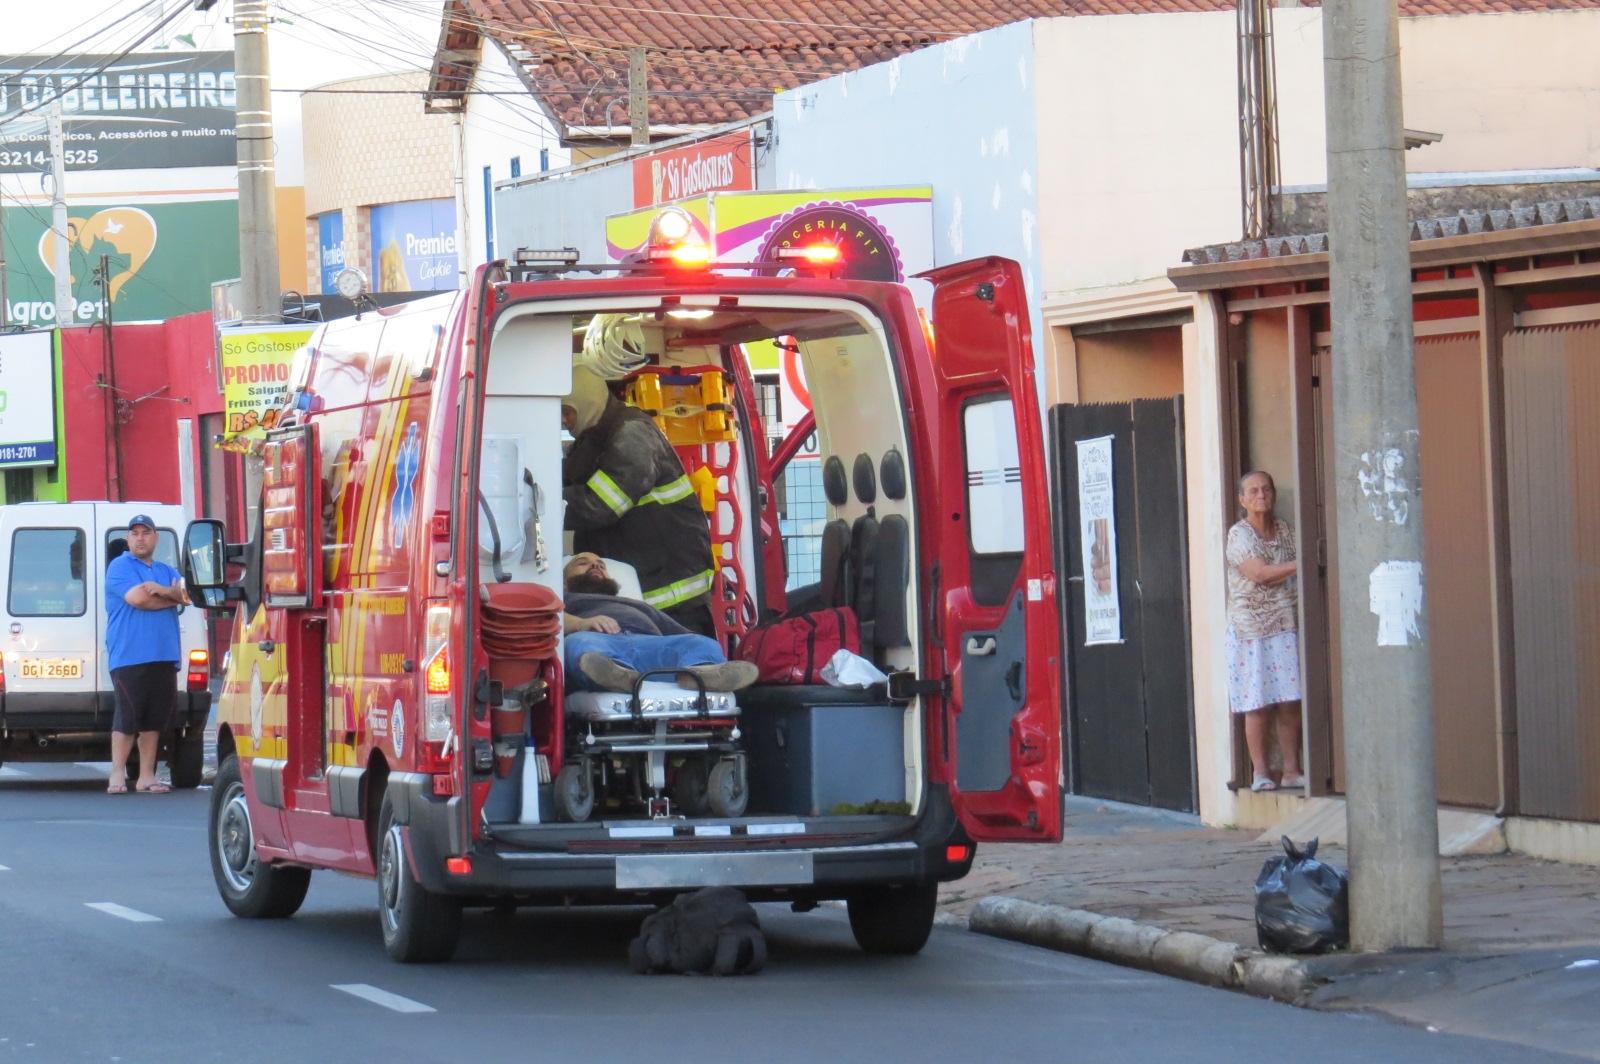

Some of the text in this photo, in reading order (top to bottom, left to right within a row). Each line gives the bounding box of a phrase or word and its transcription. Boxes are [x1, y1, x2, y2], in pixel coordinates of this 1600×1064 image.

[21, 71, 236, 111] CABELEIREIRO
[98, 129, 168, 140] Acessórios
[170, 130, 179, 138] e
[181, 127, 217, 138] muito
[220, 128, 237, 136] ma
[0, 149, 99, 166] 3214-525
[667, 151, 733, 199] Só Gostosuras
[855, 230, 879, 255] FIT
[420, 259, 452, 280] Cookie
[224, 341, 307, 355] Só Gostosur
[224, 363, 290, 386] PROMO
[248, 385, 288, 396] Salgad
[228, 399, 262, 409] Fritos
[274, 395, 286, 405] As
[229, 409, 259, 433] R$
